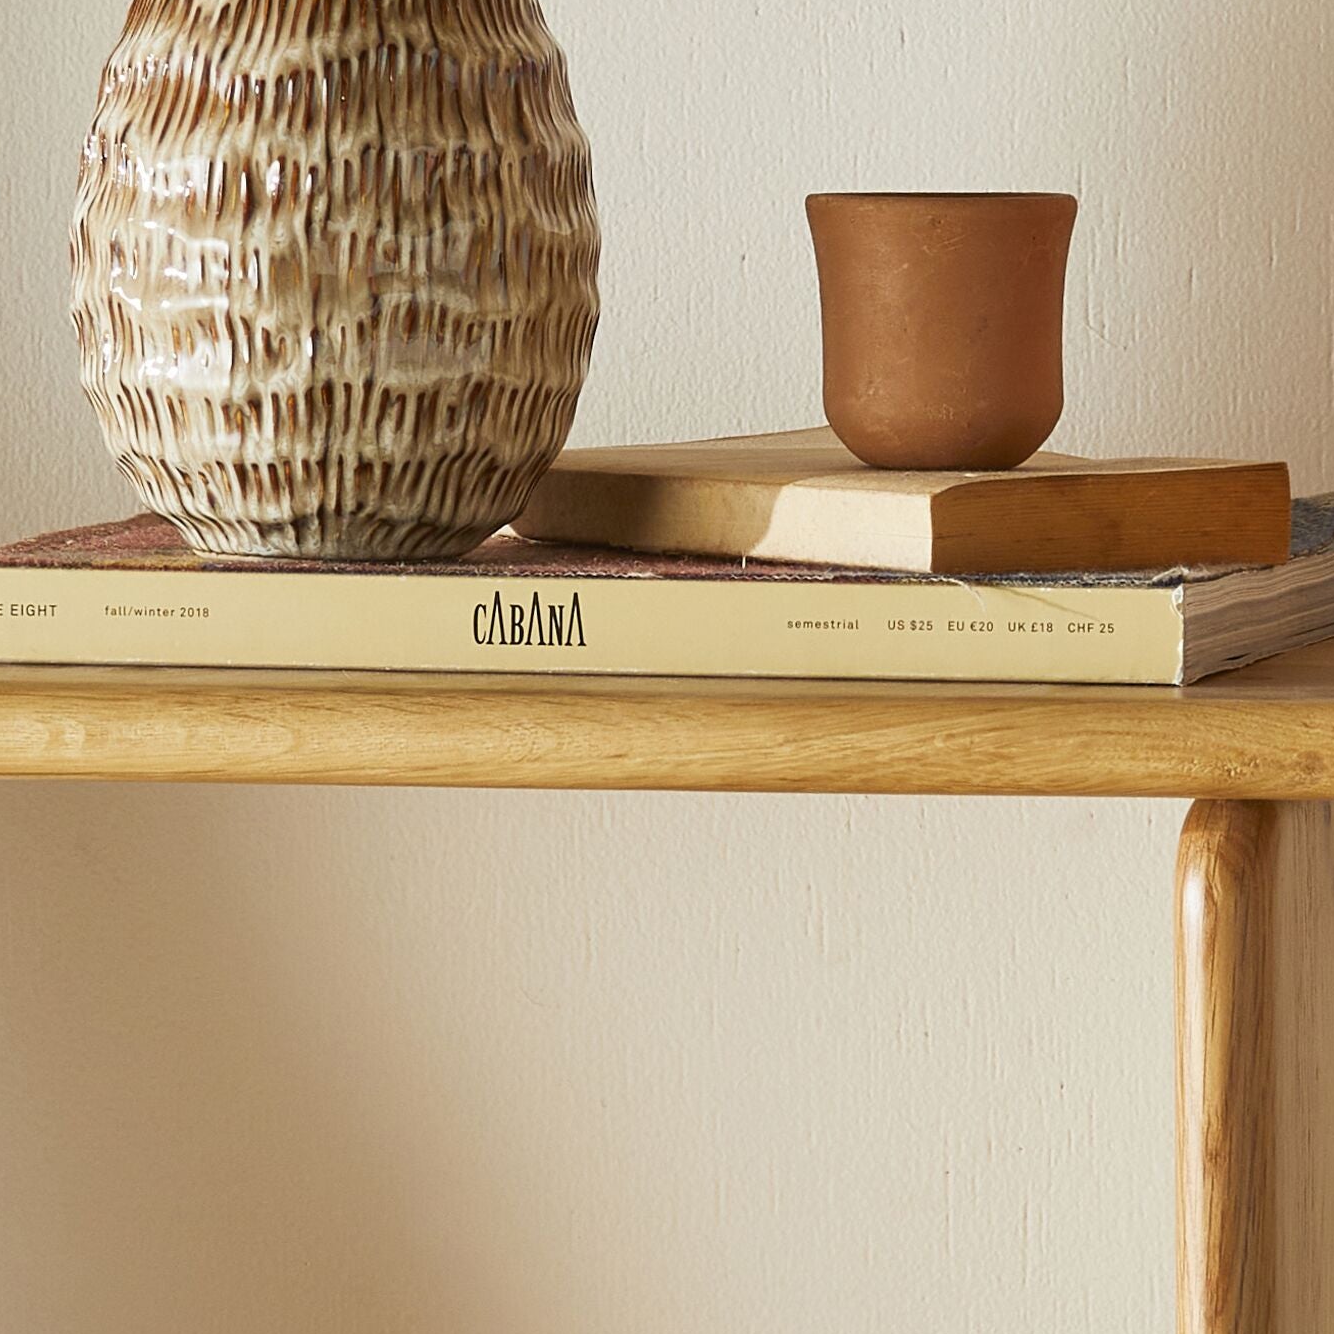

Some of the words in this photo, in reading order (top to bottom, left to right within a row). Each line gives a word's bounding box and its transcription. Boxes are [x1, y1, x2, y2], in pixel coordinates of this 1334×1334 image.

[9, 603, 58, 619] EIGHT
[104, 604, 176, 619] fall/winter
[179, 606, 210, 619] 2018
[473, 590, 587, 647] CABANA
[786, 618, 860, 631] semestrial
[886, 620, 906, 632] US
[909, 619, 934, 633] $25
[946, 621, 966, 633] EU
[969, 621, 995, 633] €20
[1007, 622, 1027, 634] UK
[1030, 621, 1054, 635] £18
[1067, 622, 1096, 635] CHF
[1099, 623, 1116, 635] 25
